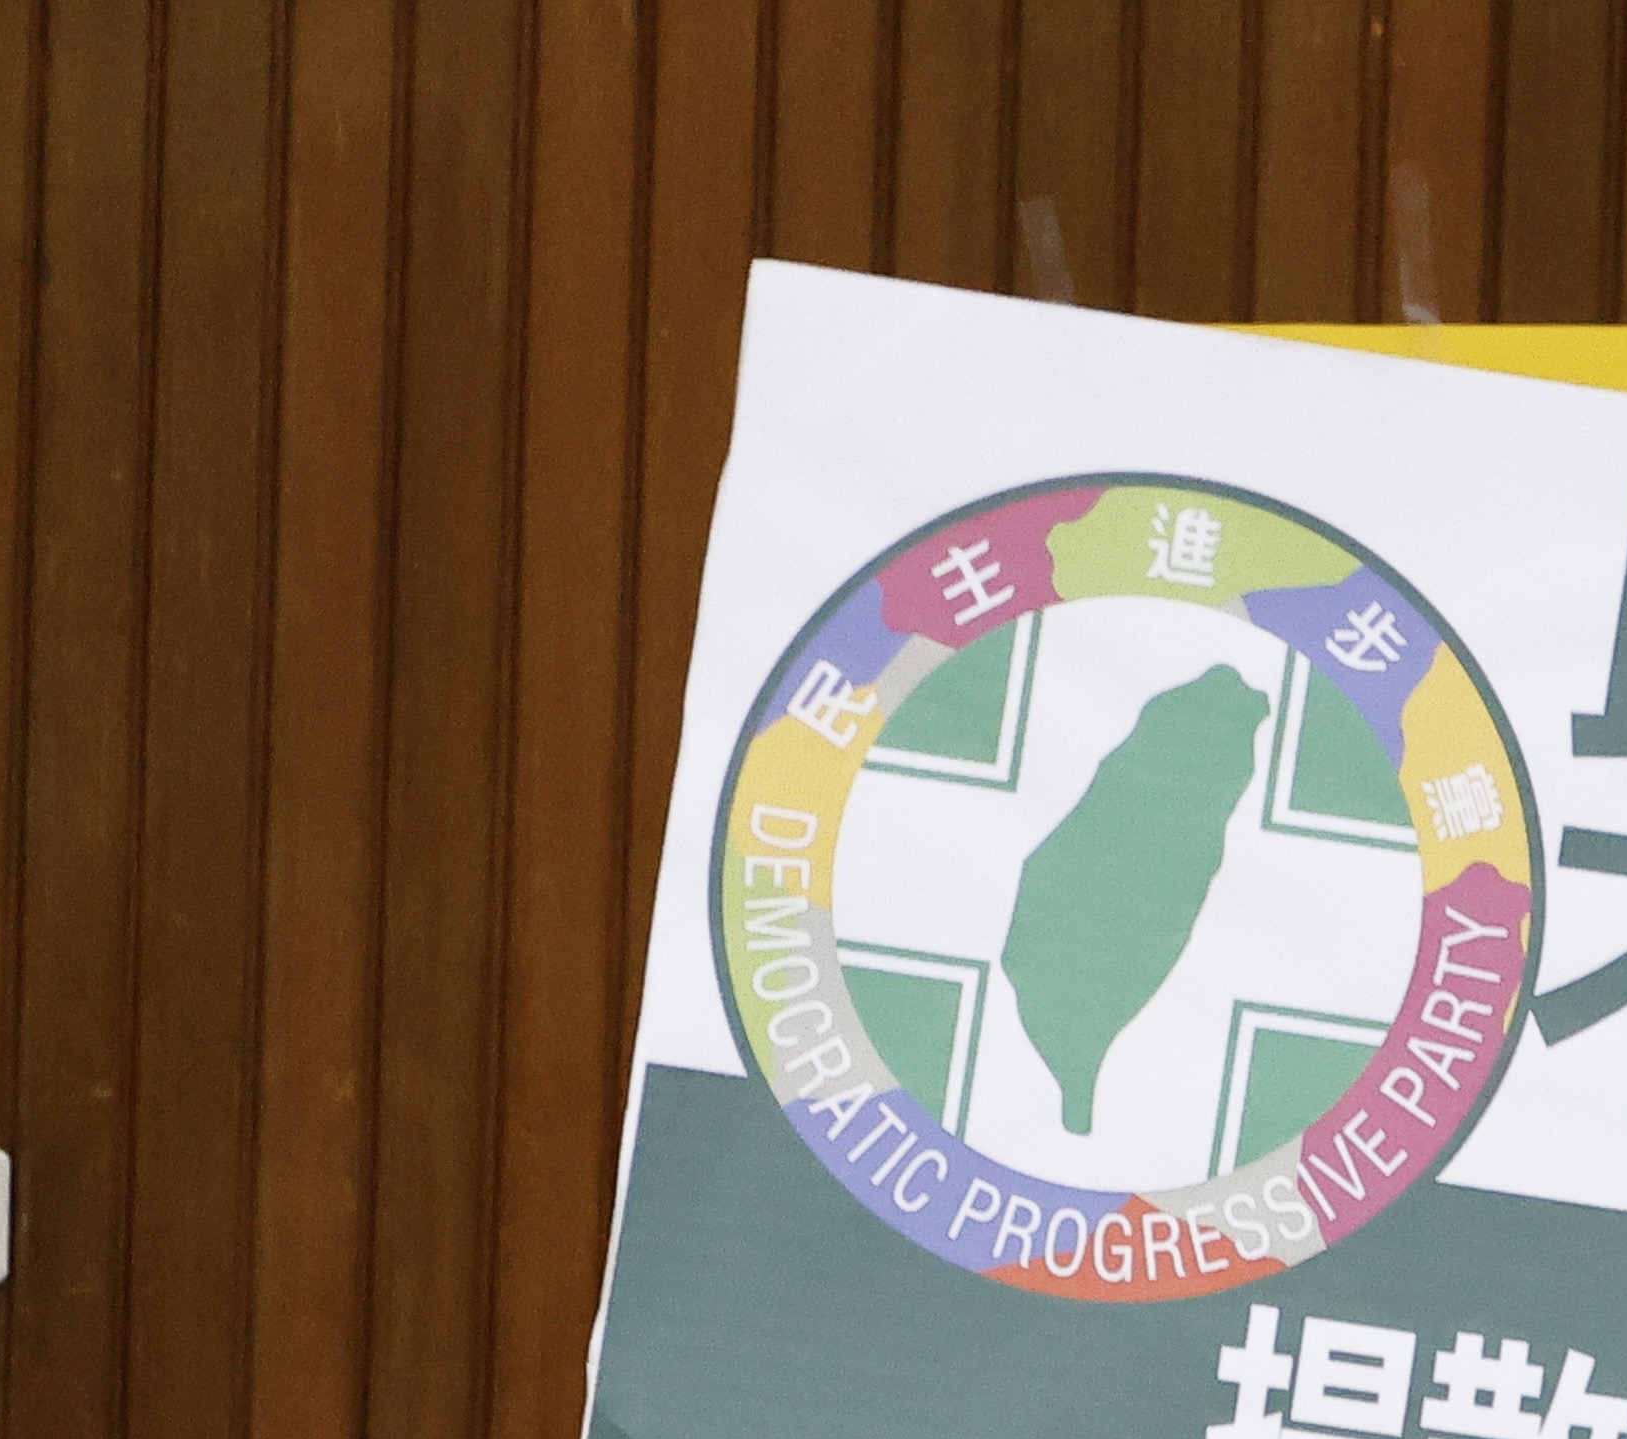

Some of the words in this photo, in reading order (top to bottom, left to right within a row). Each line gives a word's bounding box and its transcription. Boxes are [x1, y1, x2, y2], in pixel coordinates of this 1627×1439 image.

[788, 503, 1504, 843] 民主進步黨
[743, 803, 948, 1214] DEMOCRATIC
[950, 1112, 1407, 1281] PROGRESSIVE
[1383, 906, 1509, 1127] PARTY
